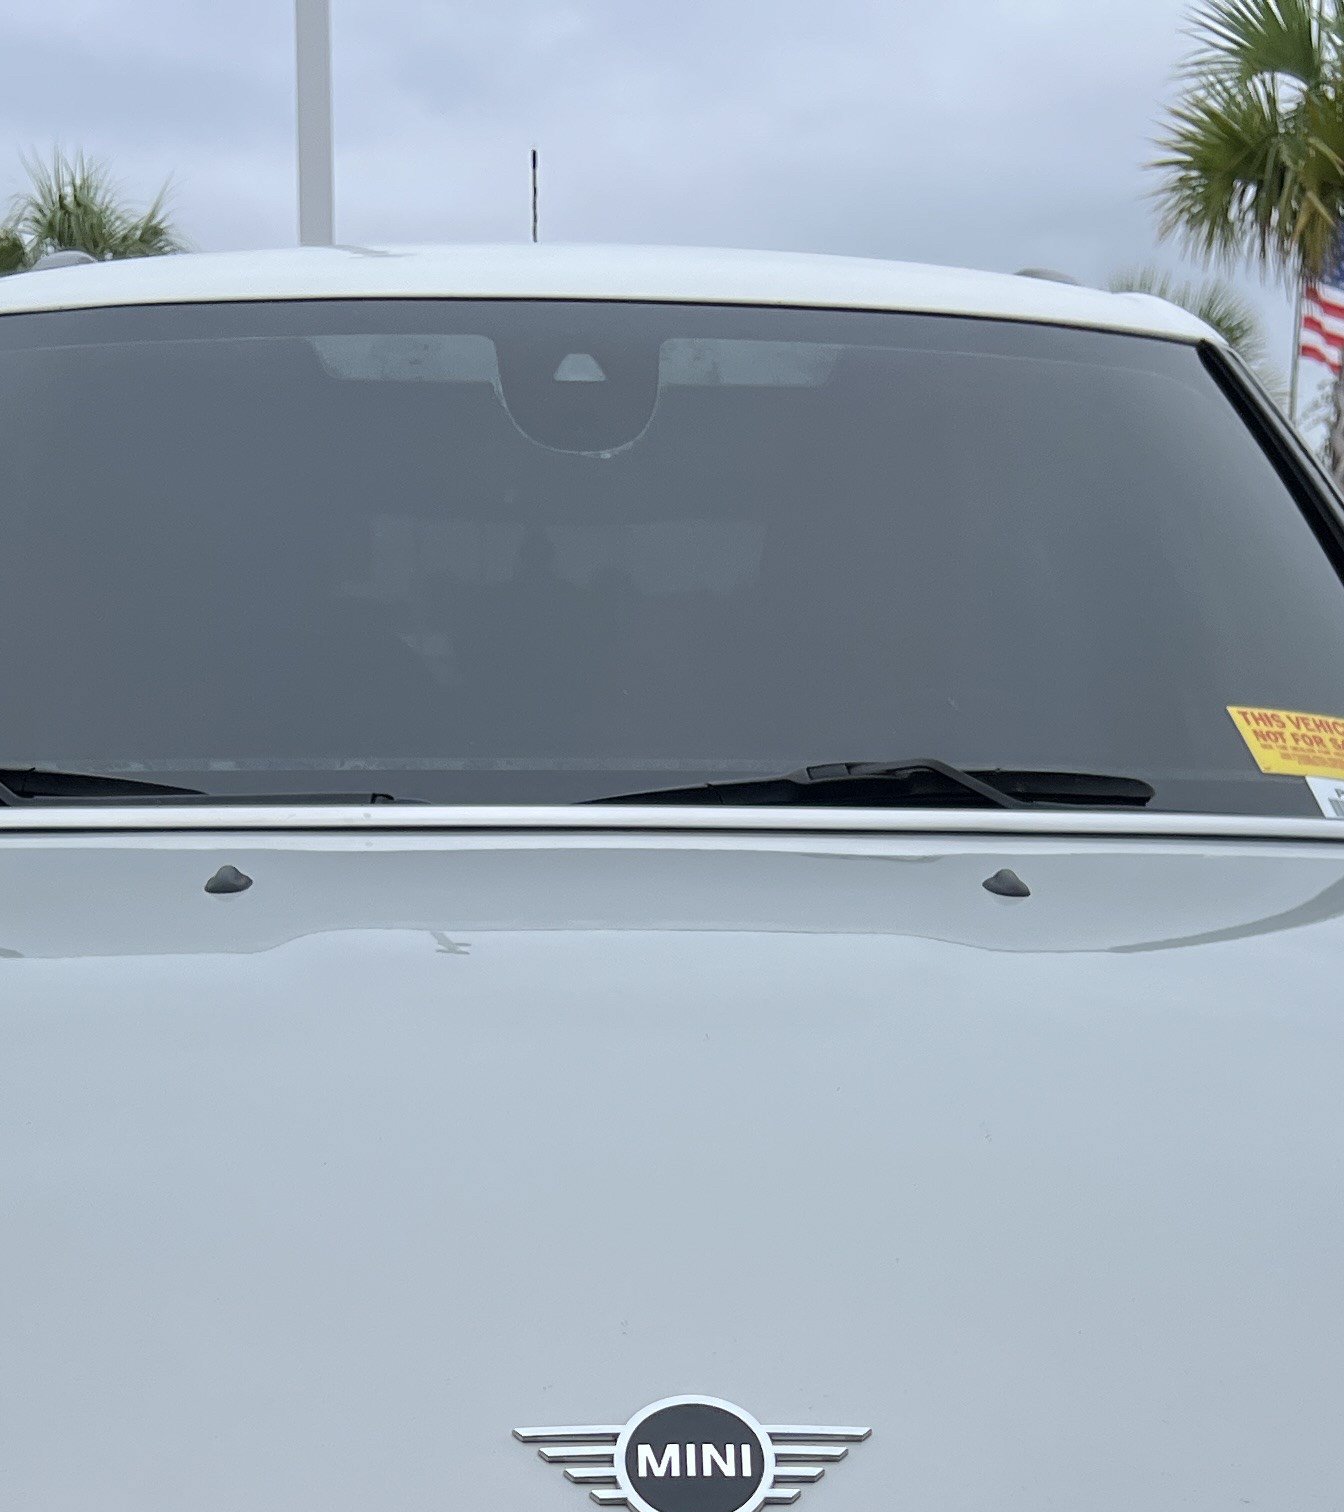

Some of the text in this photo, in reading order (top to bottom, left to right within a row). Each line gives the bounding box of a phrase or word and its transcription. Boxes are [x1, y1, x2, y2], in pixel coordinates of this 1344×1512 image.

[1237, 710, 1286, 729] THIS
[1252, 729, 1287, 745] NOT
[1290, 732, 1326, 749] FOR
[636, 1443, 752, 1477] MINI
